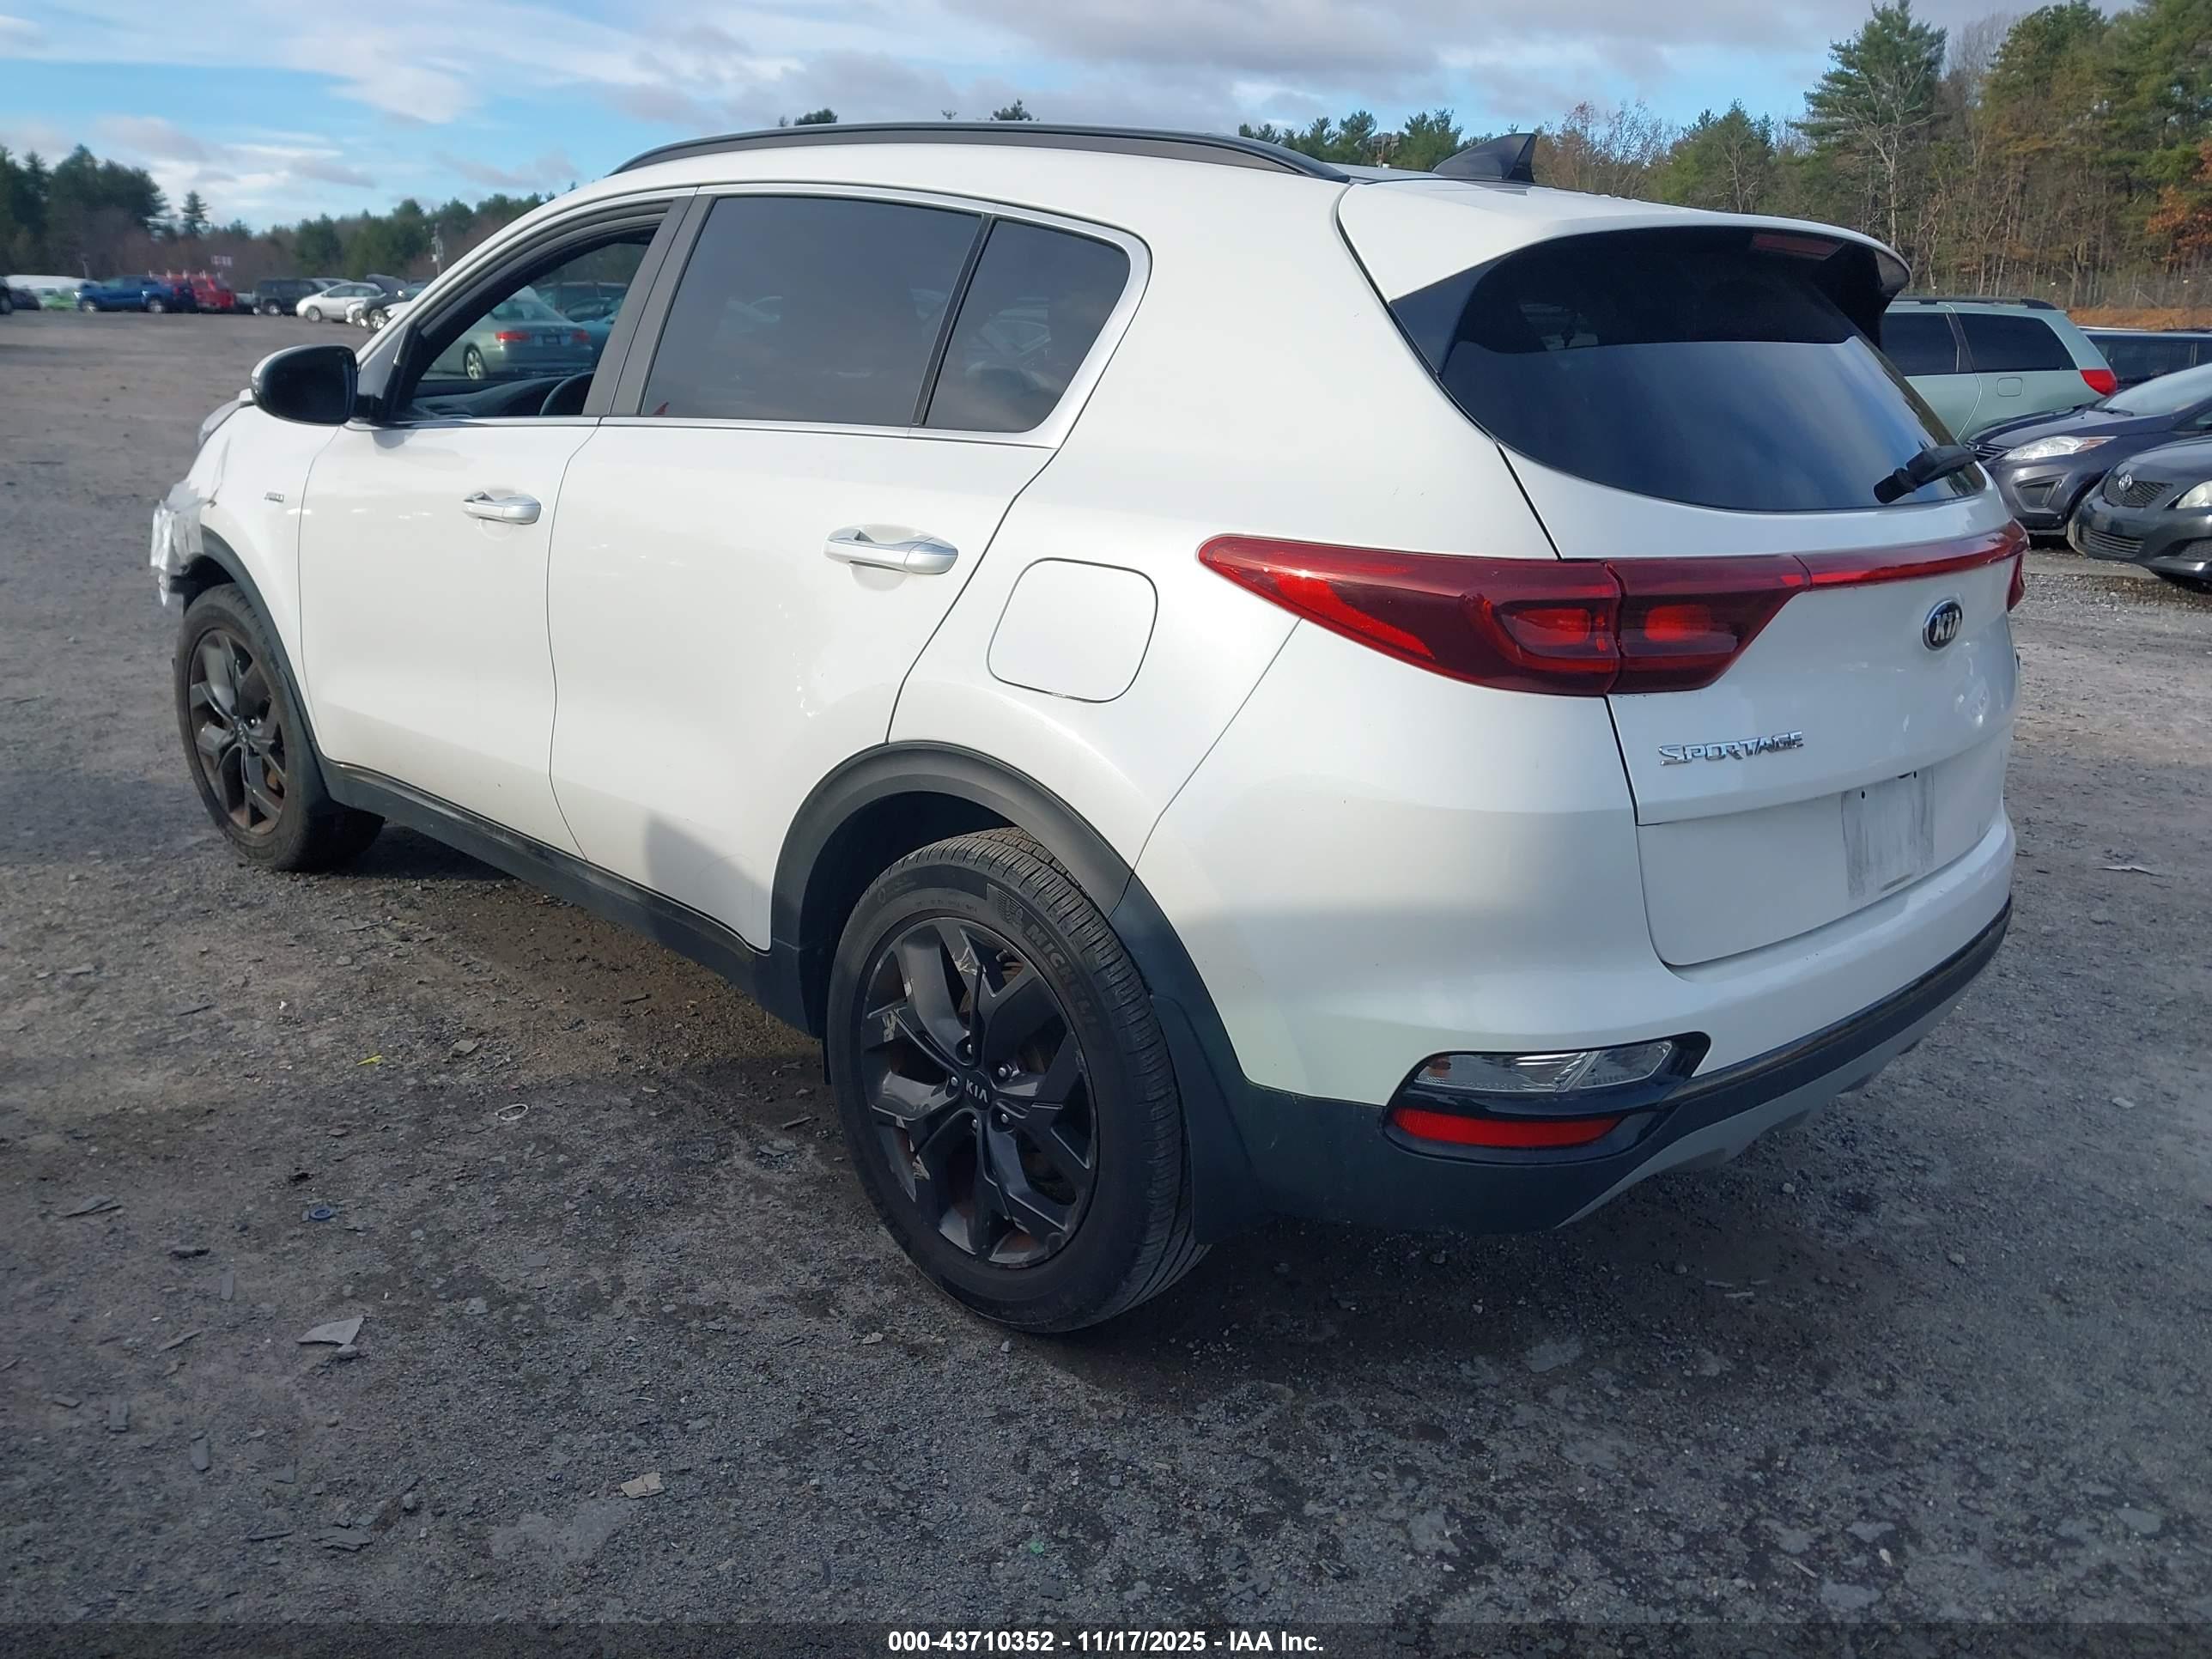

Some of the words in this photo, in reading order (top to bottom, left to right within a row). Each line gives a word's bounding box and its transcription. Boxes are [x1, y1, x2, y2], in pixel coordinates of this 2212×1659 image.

[1658, 731, 1804, 766] SPORTAGE
[1025, 923, 1102, 1040] MICHELI
[965, 1078, 988, 1103] KIA
